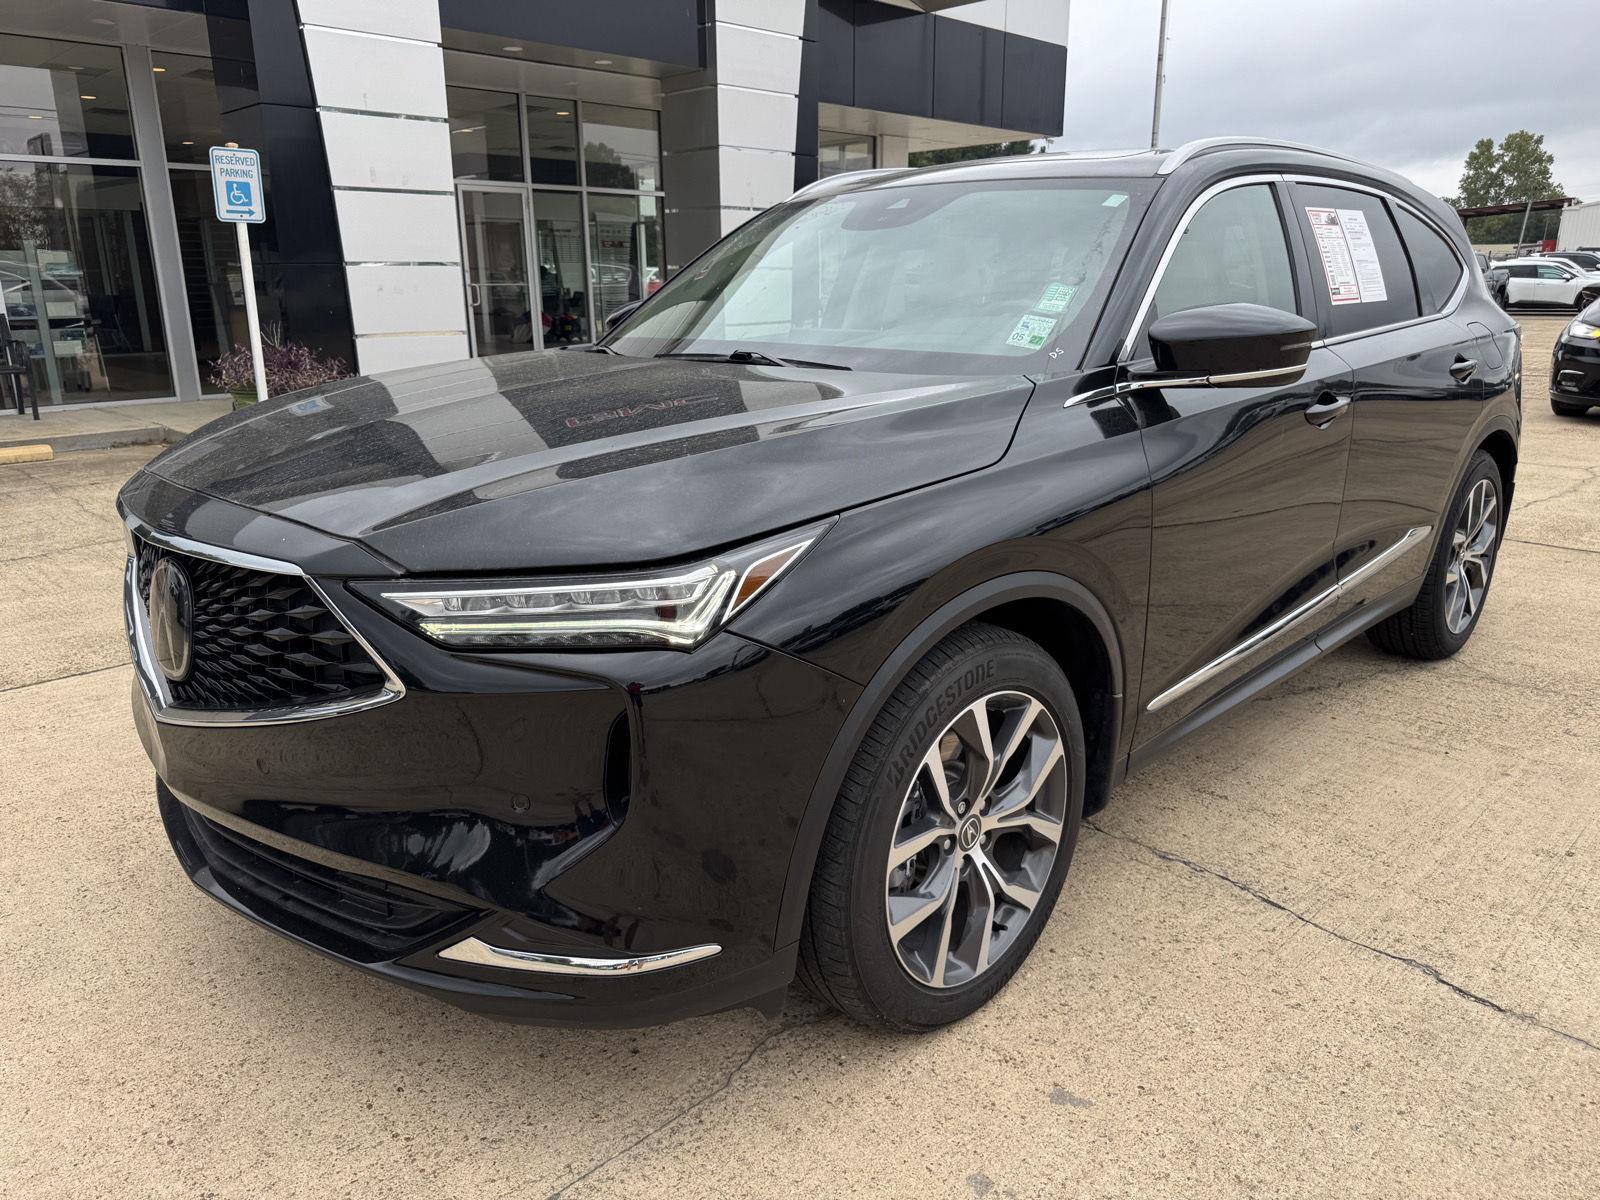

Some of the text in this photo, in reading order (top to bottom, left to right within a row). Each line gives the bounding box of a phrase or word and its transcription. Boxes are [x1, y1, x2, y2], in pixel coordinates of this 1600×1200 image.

[214, 155, 256, 166] RESERVED
[220, 168, 254, 178] PARKING
[1012, 332, 1025, 341] 05
[1030, 336, 1044, 344] 27
[886, 659, 995, 788] BRIDGESTONE
